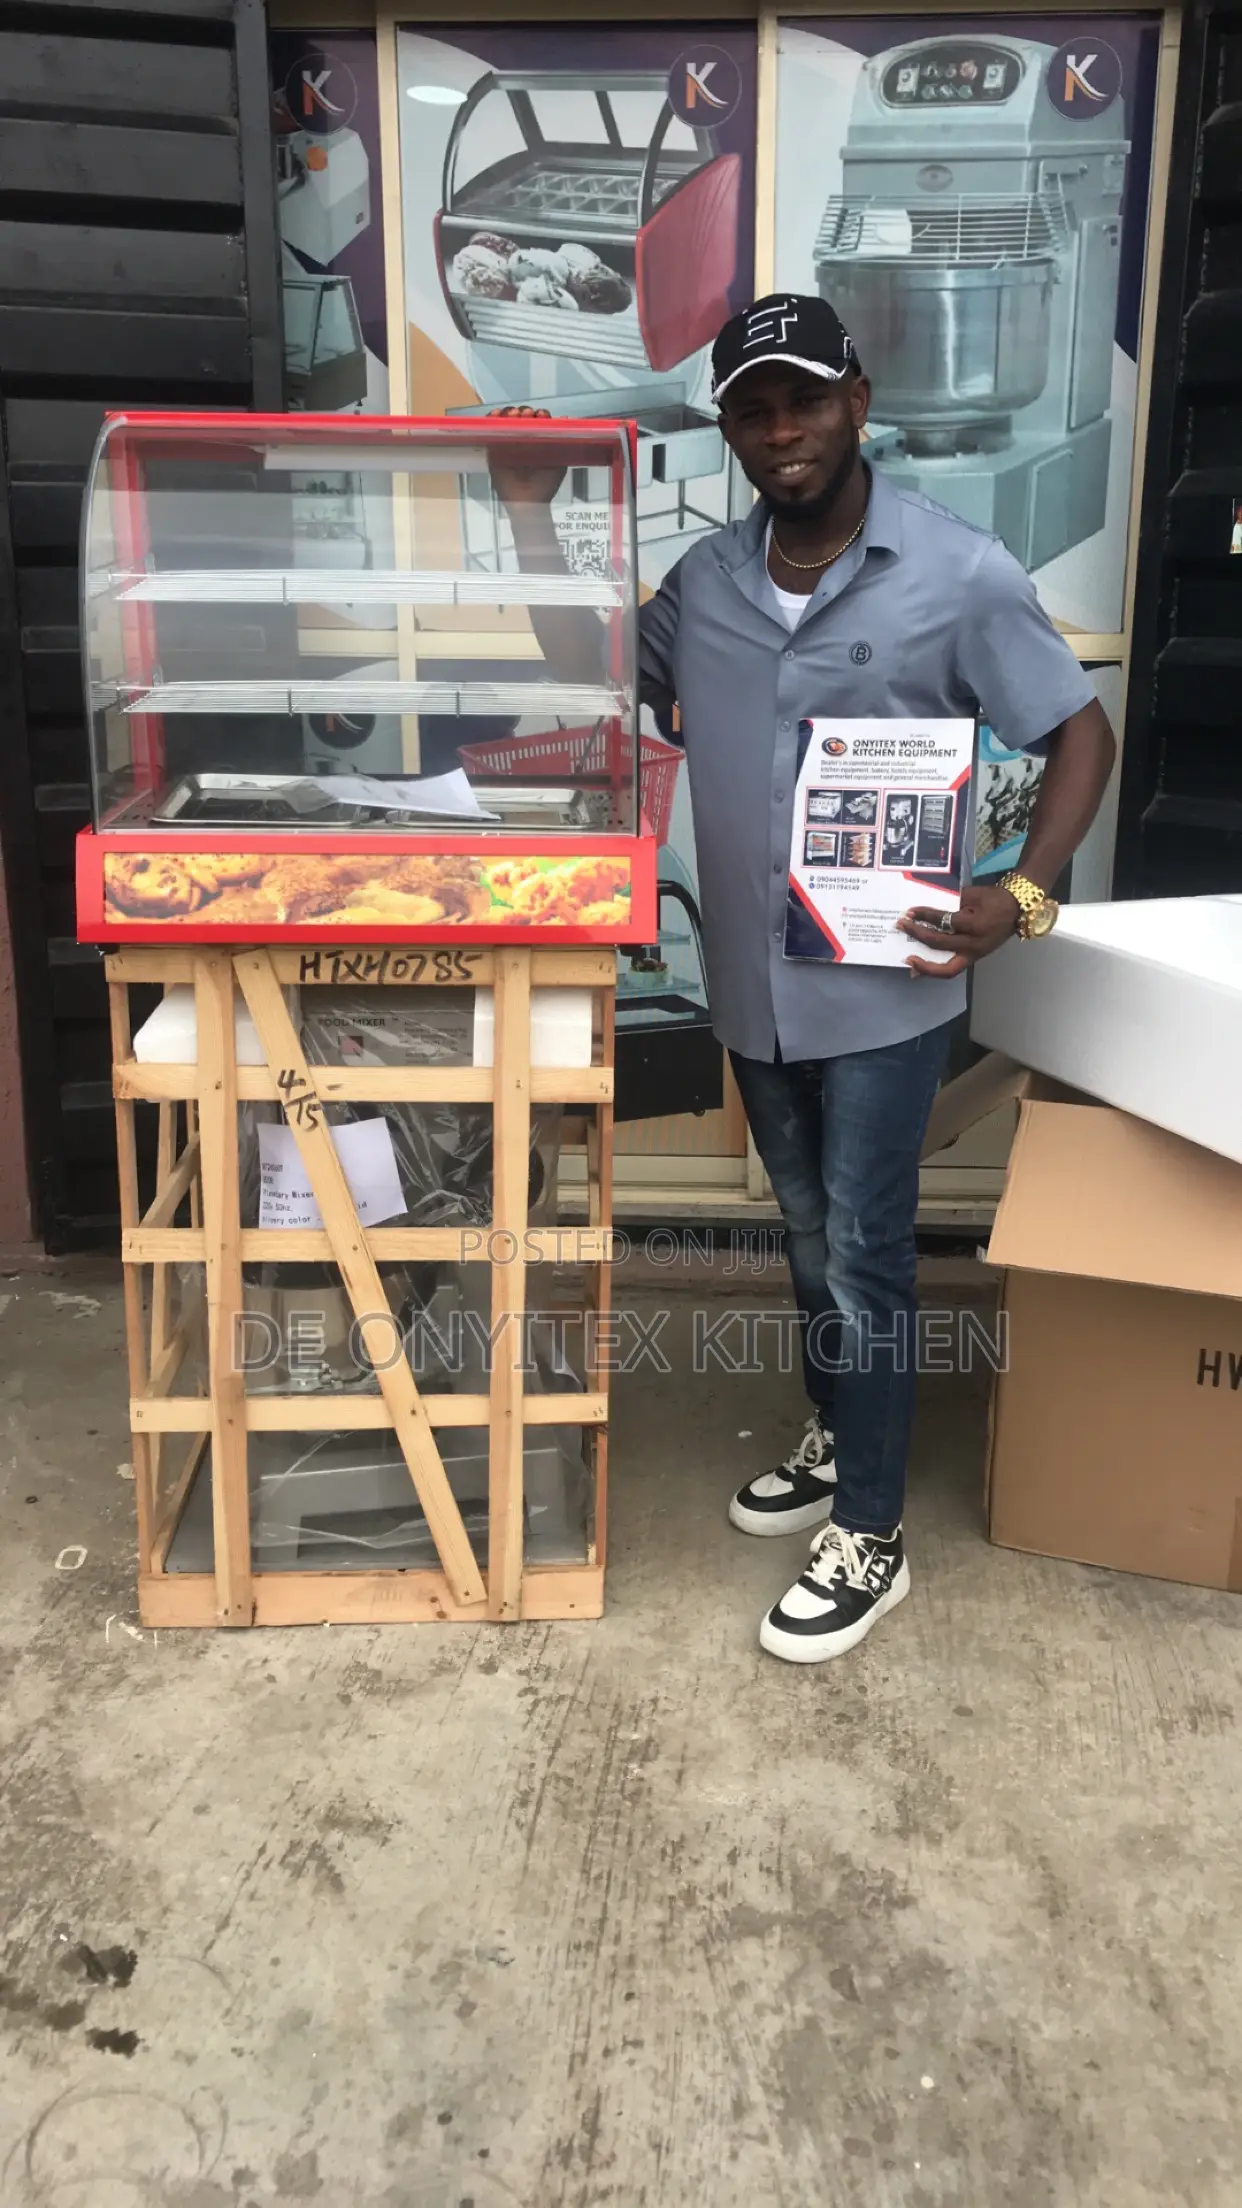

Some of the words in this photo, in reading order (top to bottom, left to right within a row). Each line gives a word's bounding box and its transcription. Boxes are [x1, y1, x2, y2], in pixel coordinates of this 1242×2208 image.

[565, 512, 592, 521] SCAN
[594, 512, 609, 521] ME
[852, 739, 896, 748] ONYITEX
[898, 739, 936, 748] WORLD
[852, 748, 896, 757] KITCHEN
[898, 748, 958, 758] EQUIPMENT
[854, 774, 882, 782] equipment
[893, 774, 914, 782] general
[288, 1214, 312, 1225] color
